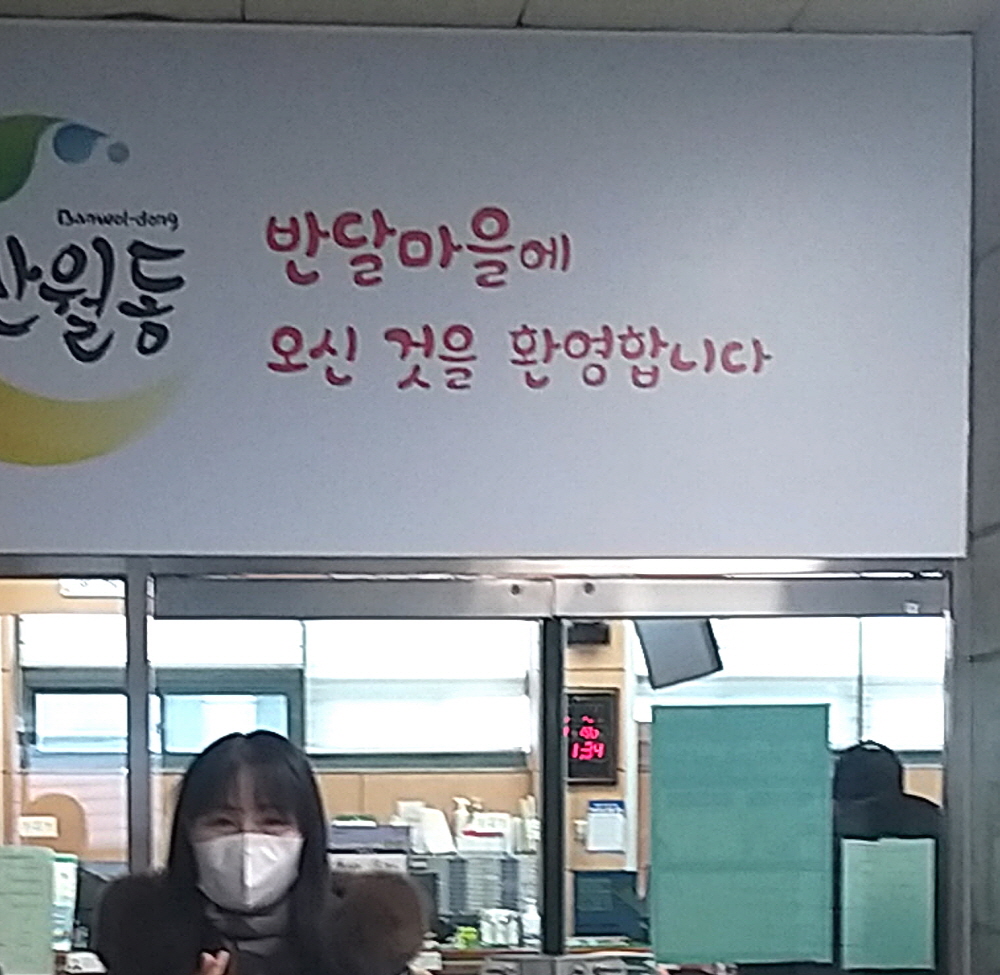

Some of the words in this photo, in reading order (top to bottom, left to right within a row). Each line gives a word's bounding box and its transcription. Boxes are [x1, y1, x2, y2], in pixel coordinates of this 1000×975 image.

[265, 205, 571, 288] 반달마을에
[267, 325, 358, 386] 오신
[384, 324, 478, 390] 것을
[508, 323, 774, 389] 환영합니다
